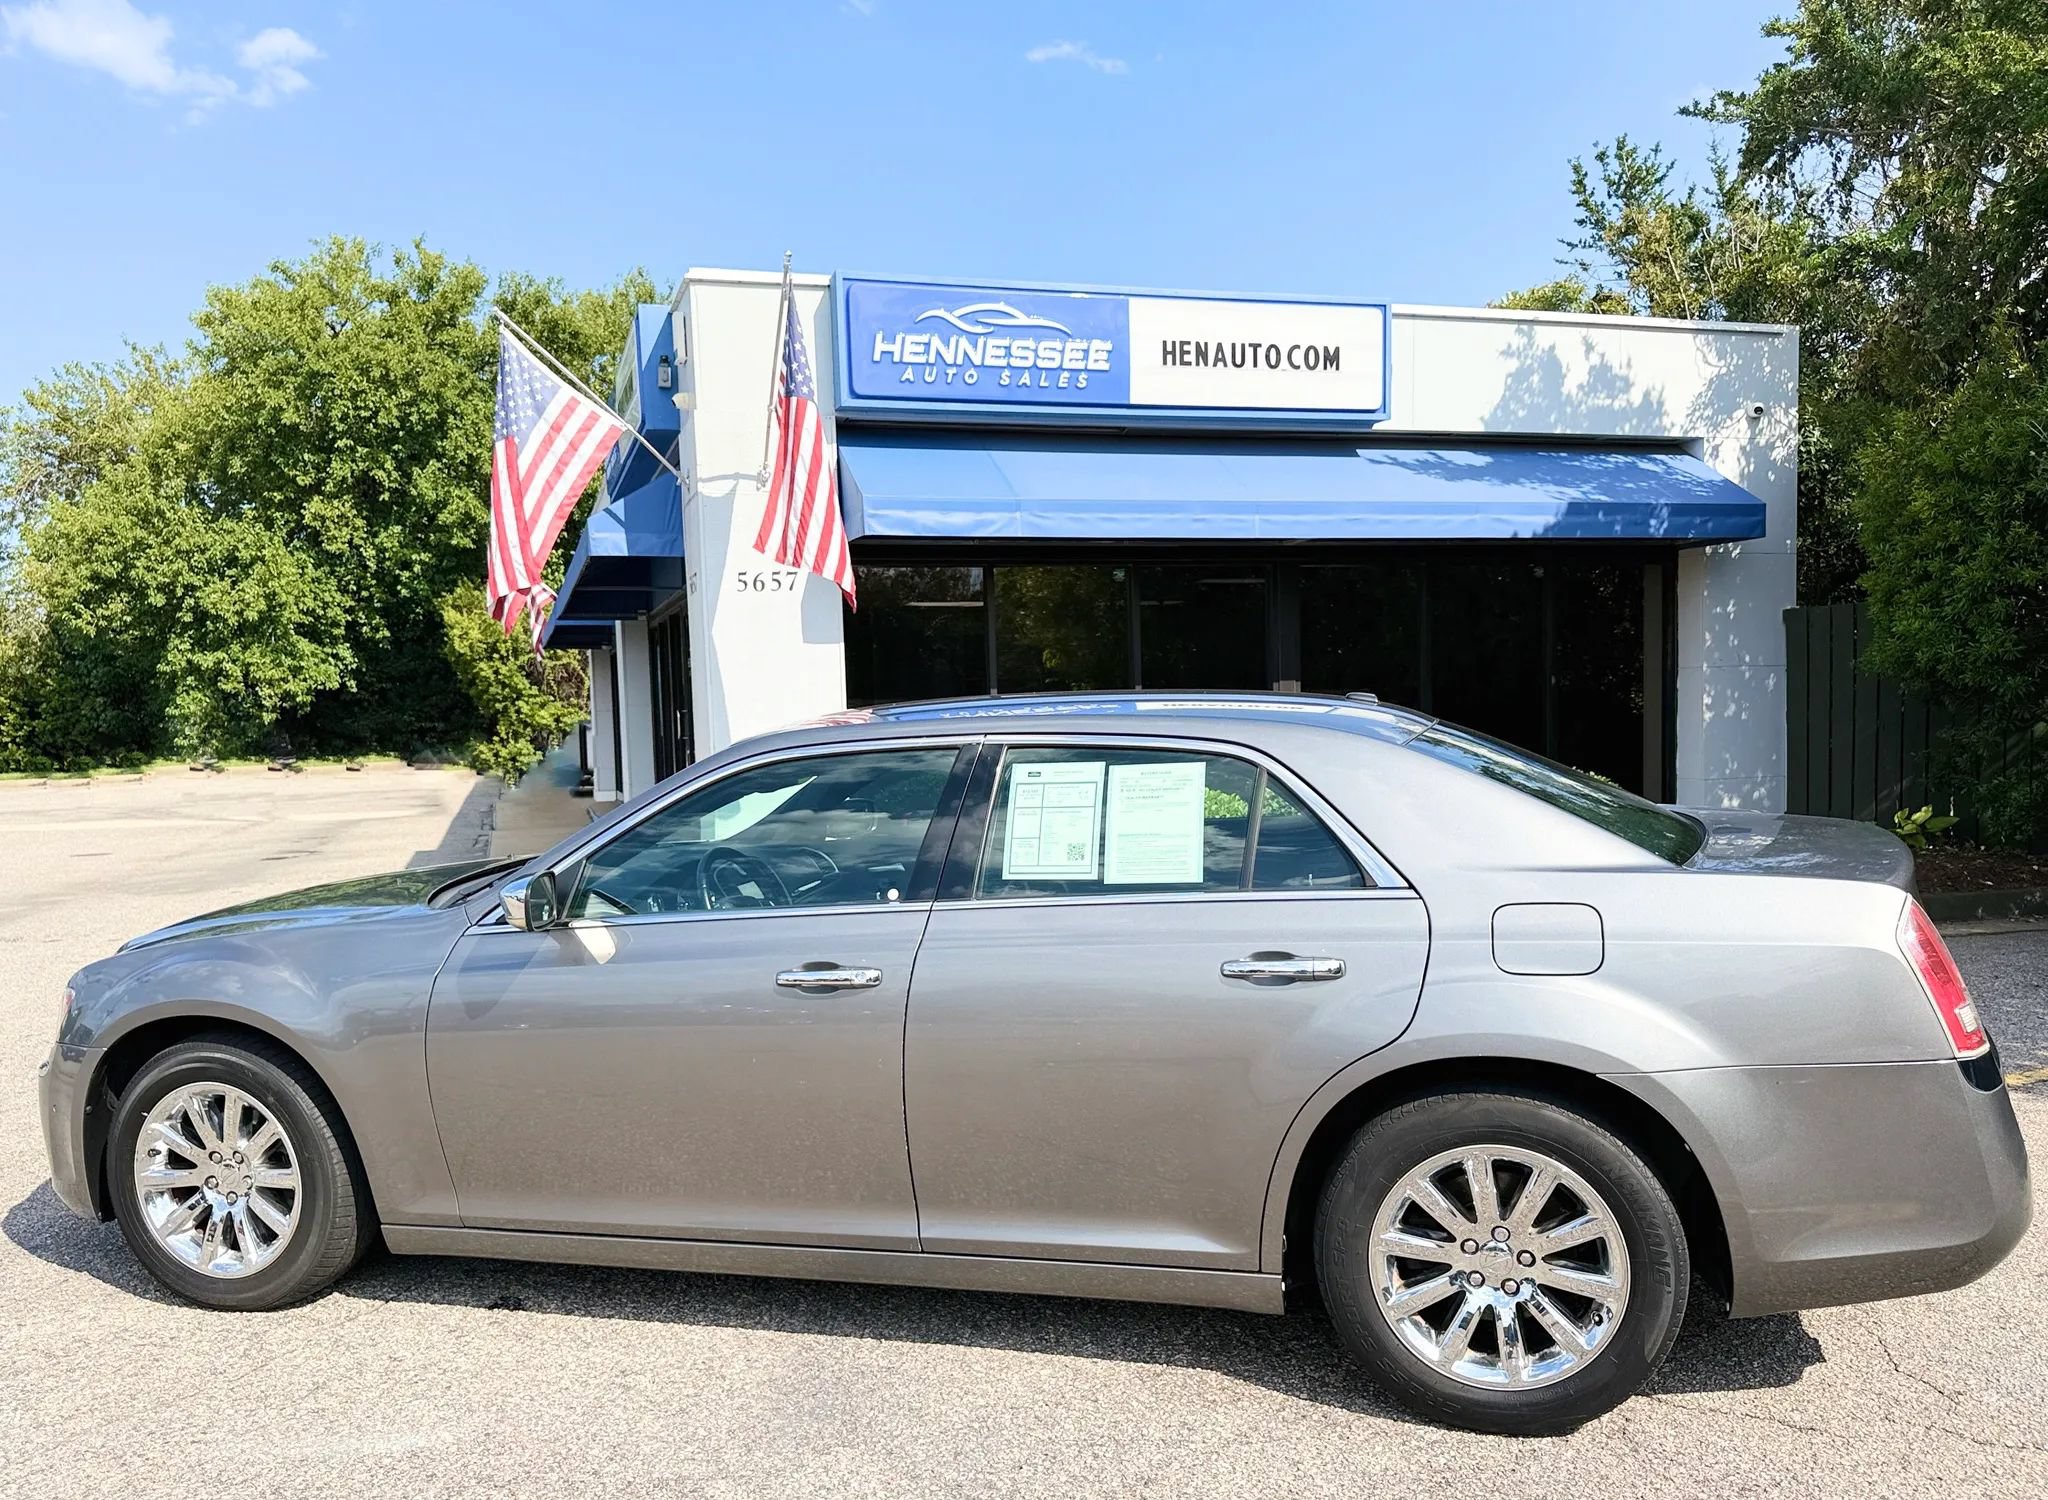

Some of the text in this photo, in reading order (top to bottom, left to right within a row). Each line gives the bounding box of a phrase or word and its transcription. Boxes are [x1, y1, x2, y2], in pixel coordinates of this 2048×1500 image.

[872, 329, 1113, 371] HENNESSEE
[900, 364, 1089, 389] AUTO SALES
[736, 569, 799, 593] 5657
